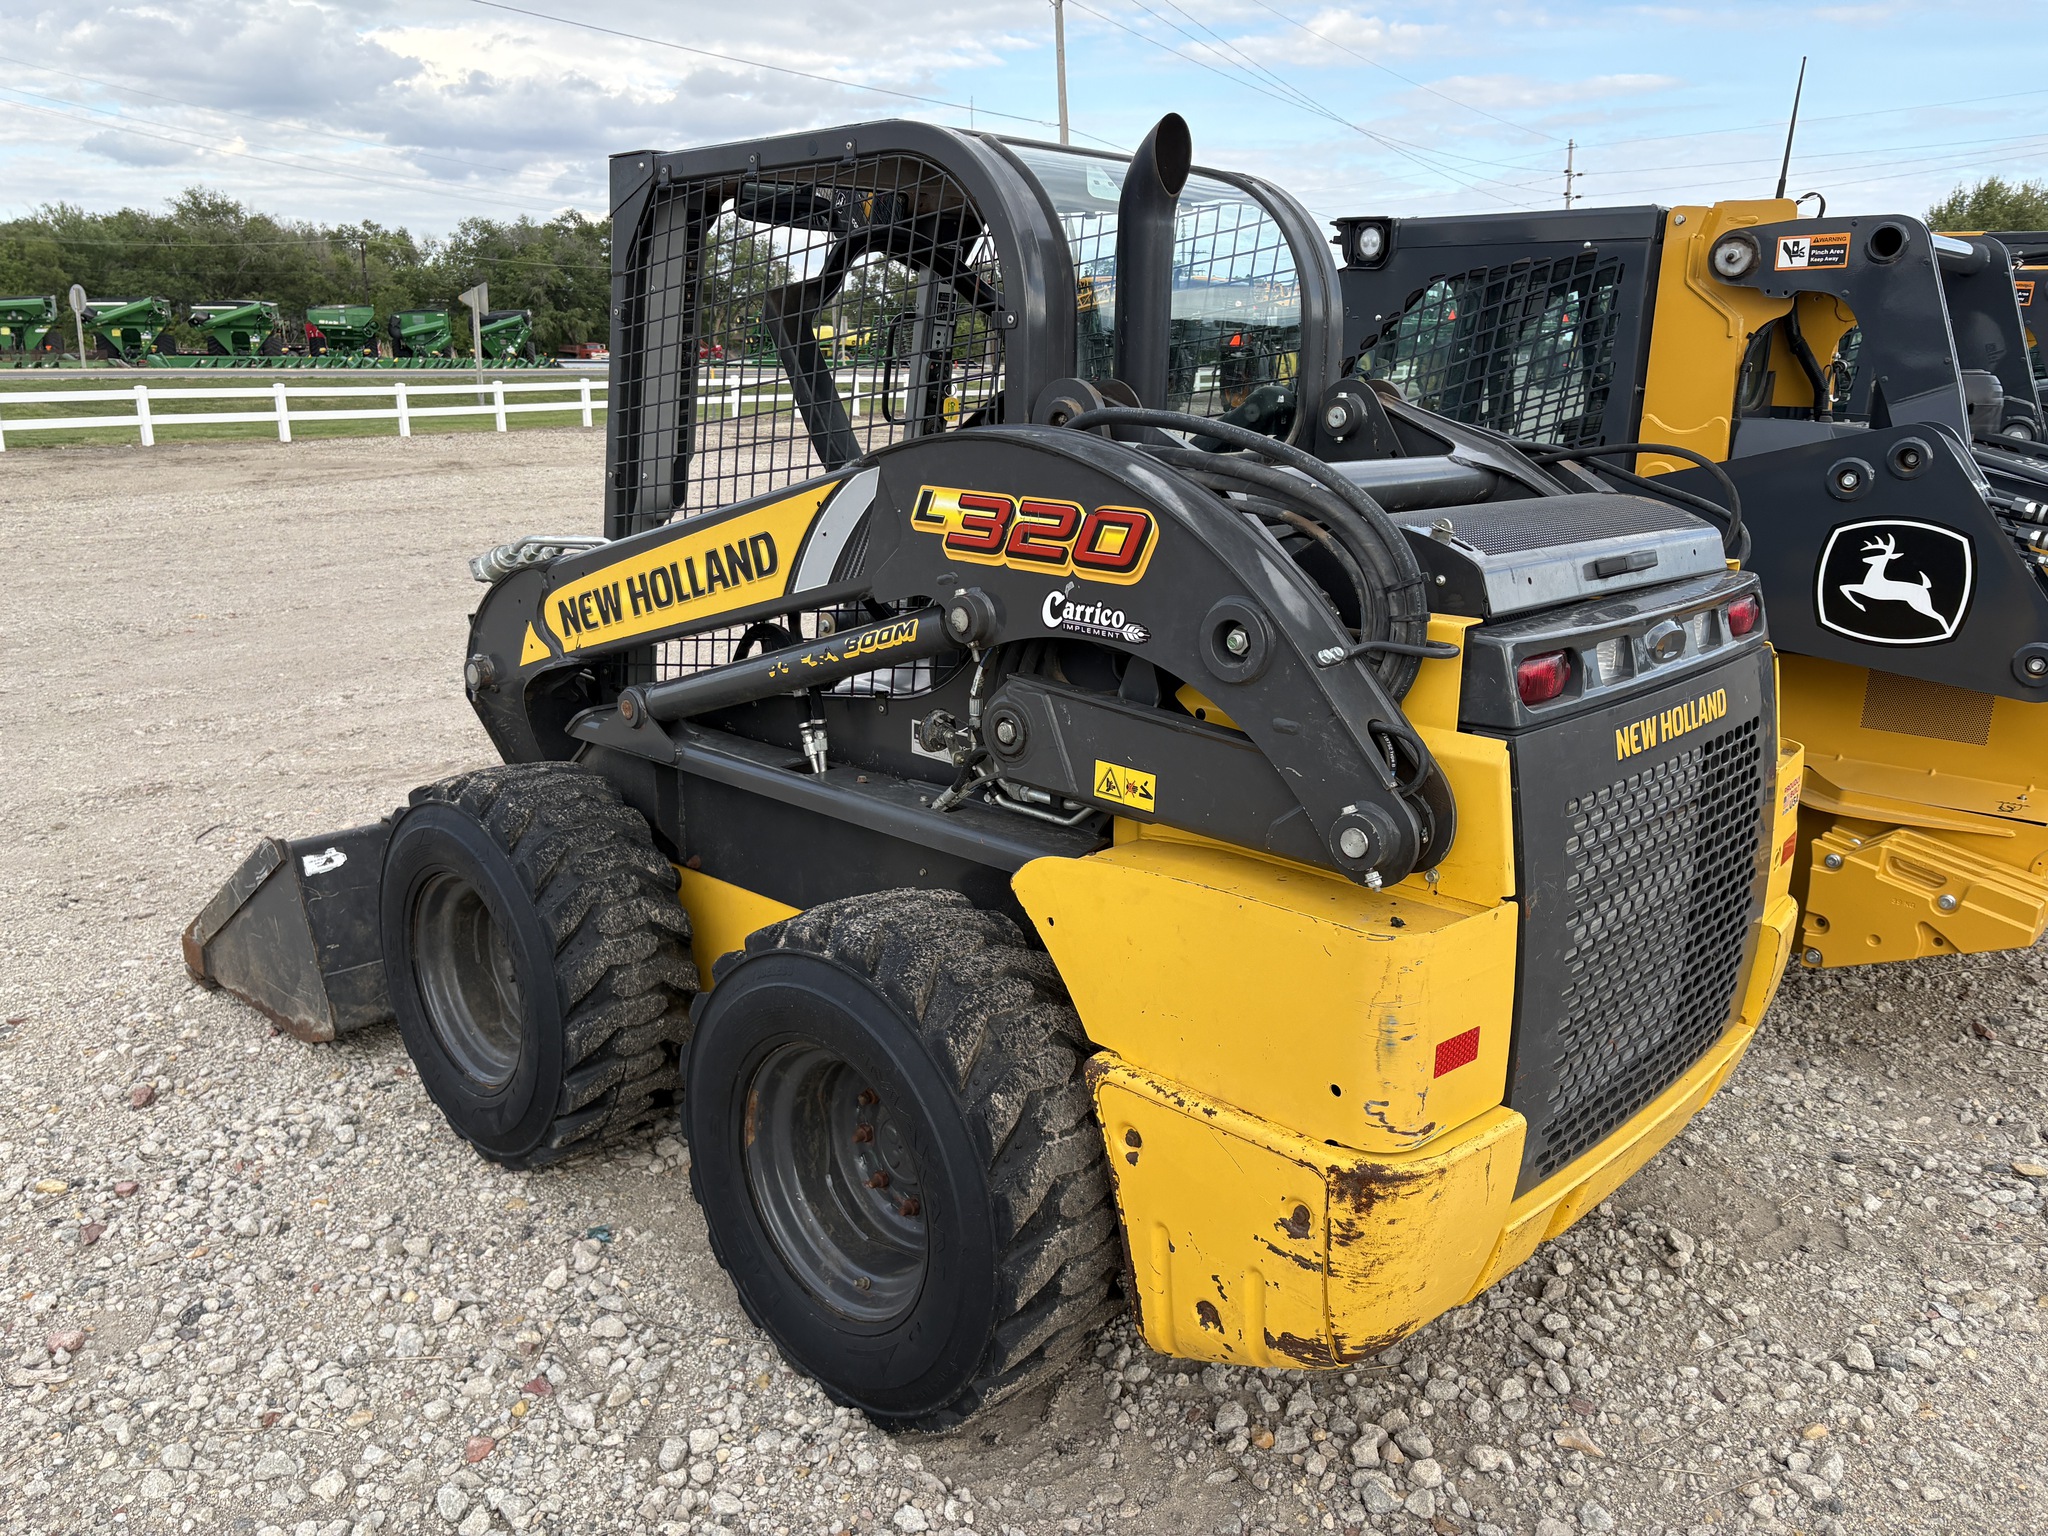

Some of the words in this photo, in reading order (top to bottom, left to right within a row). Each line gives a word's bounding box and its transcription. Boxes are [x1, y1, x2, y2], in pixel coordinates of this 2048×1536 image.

[1811, 248, 1828, 256] Pinch
[912, 487, 1157, 577] L320
[557, 581, 624, 638] NEW
[626, 531, 779, 618] HOLLAND
[1042, 590, 1126, 629] Carrico
[1062, 623, 1121, 639] IMPLEMENT
[1615, 715, 1658, 761] NEW
[1660, 688, 1728, 743] HOLLAND
